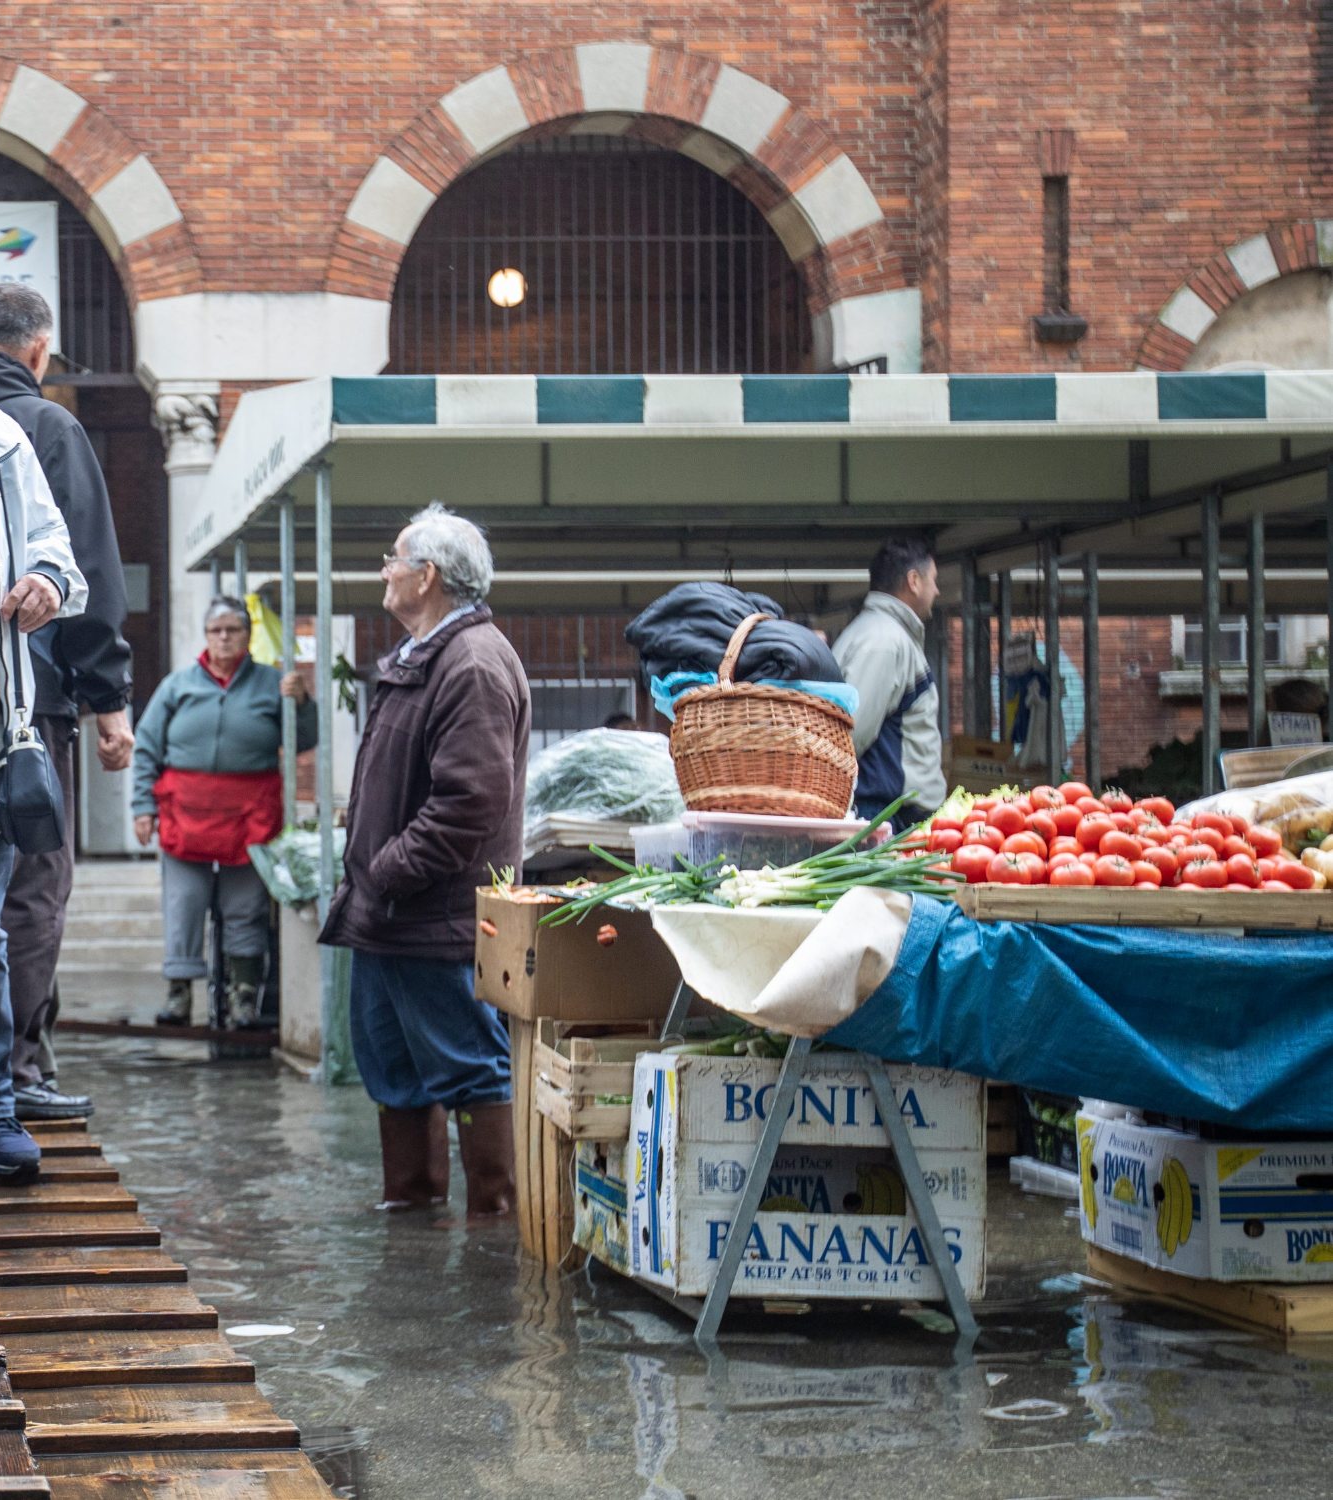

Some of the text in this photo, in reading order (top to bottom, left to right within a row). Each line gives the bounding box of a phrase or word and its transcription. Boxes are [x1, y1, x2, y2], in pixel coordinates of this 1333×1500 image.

[722, 1082, 932, 1129] BONITA
[634, 1130, 650, 1201] BONITA
[1103, 1151, 1150, 1209] BONITA
[1259, 1154, 1326, 1168] PREMIUM
[762, 1174, 832, 1213] NITA
[706, 1219, 963, 1267] BANANAS
[744, 1265, 787, 1280] KEEP
[791, 1267, 811, 1281] AT
[815, 1267, 832, 1282] 58
[857, 1270, 879, 1283] OR
[883, 1268, 899, 1283] 14
